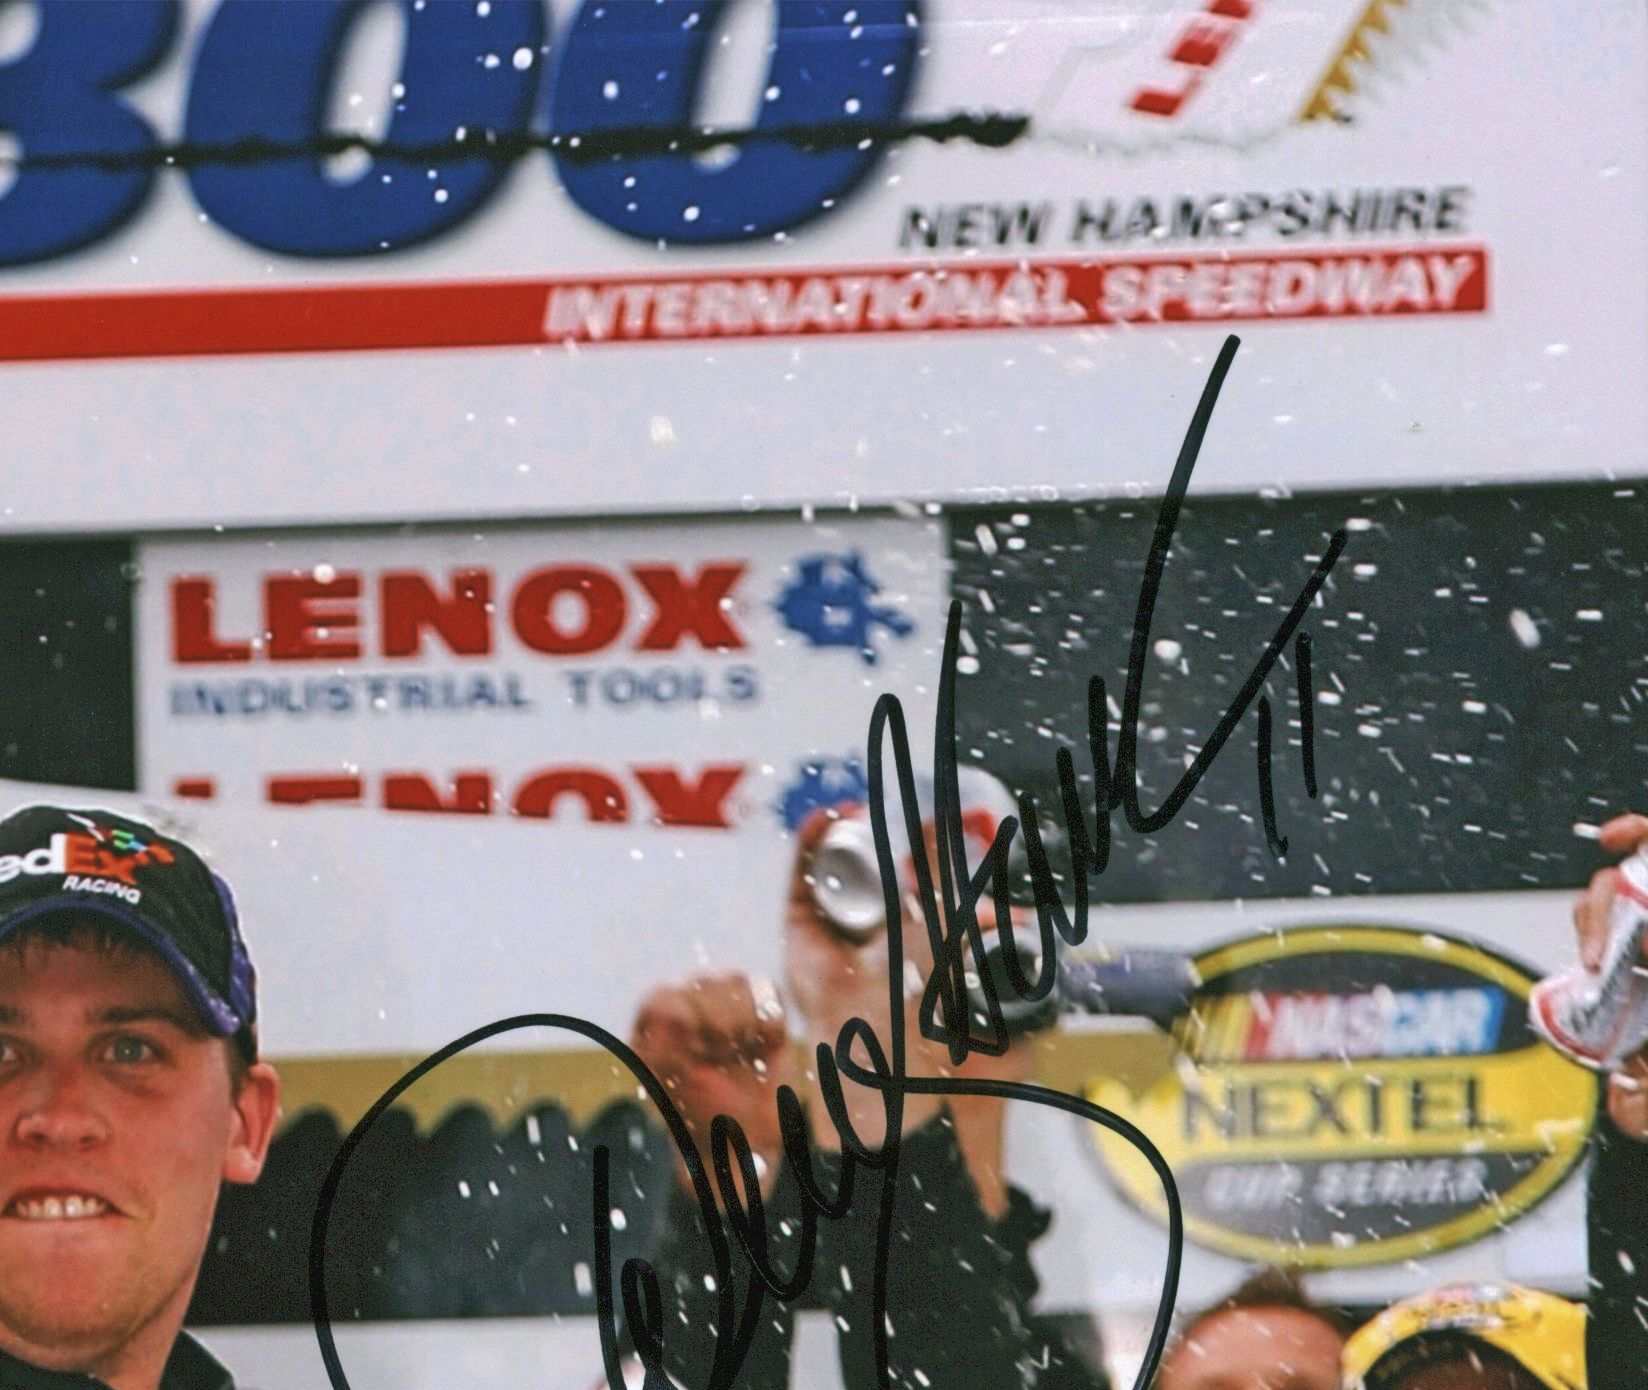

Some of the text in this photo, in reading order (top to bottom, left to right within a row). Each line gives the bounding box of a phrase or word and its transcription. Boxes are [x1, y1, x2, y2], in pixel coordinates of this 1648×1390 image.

[898, 185, 1477, 252] NEW HAMPSHIRE
[542, 247, 1475, 337] INTERNATIONAL SPEEDWAY
[168, 563, 750, 665] LENOX
[169, 662, 762, 718] INDUSTRIAL TOOLS
[62, 873, 142, 905] RACING
[1266, 990, 1492, 1060] NASCAR
[1180, 1078, 1502, 1138] NEXTEL
